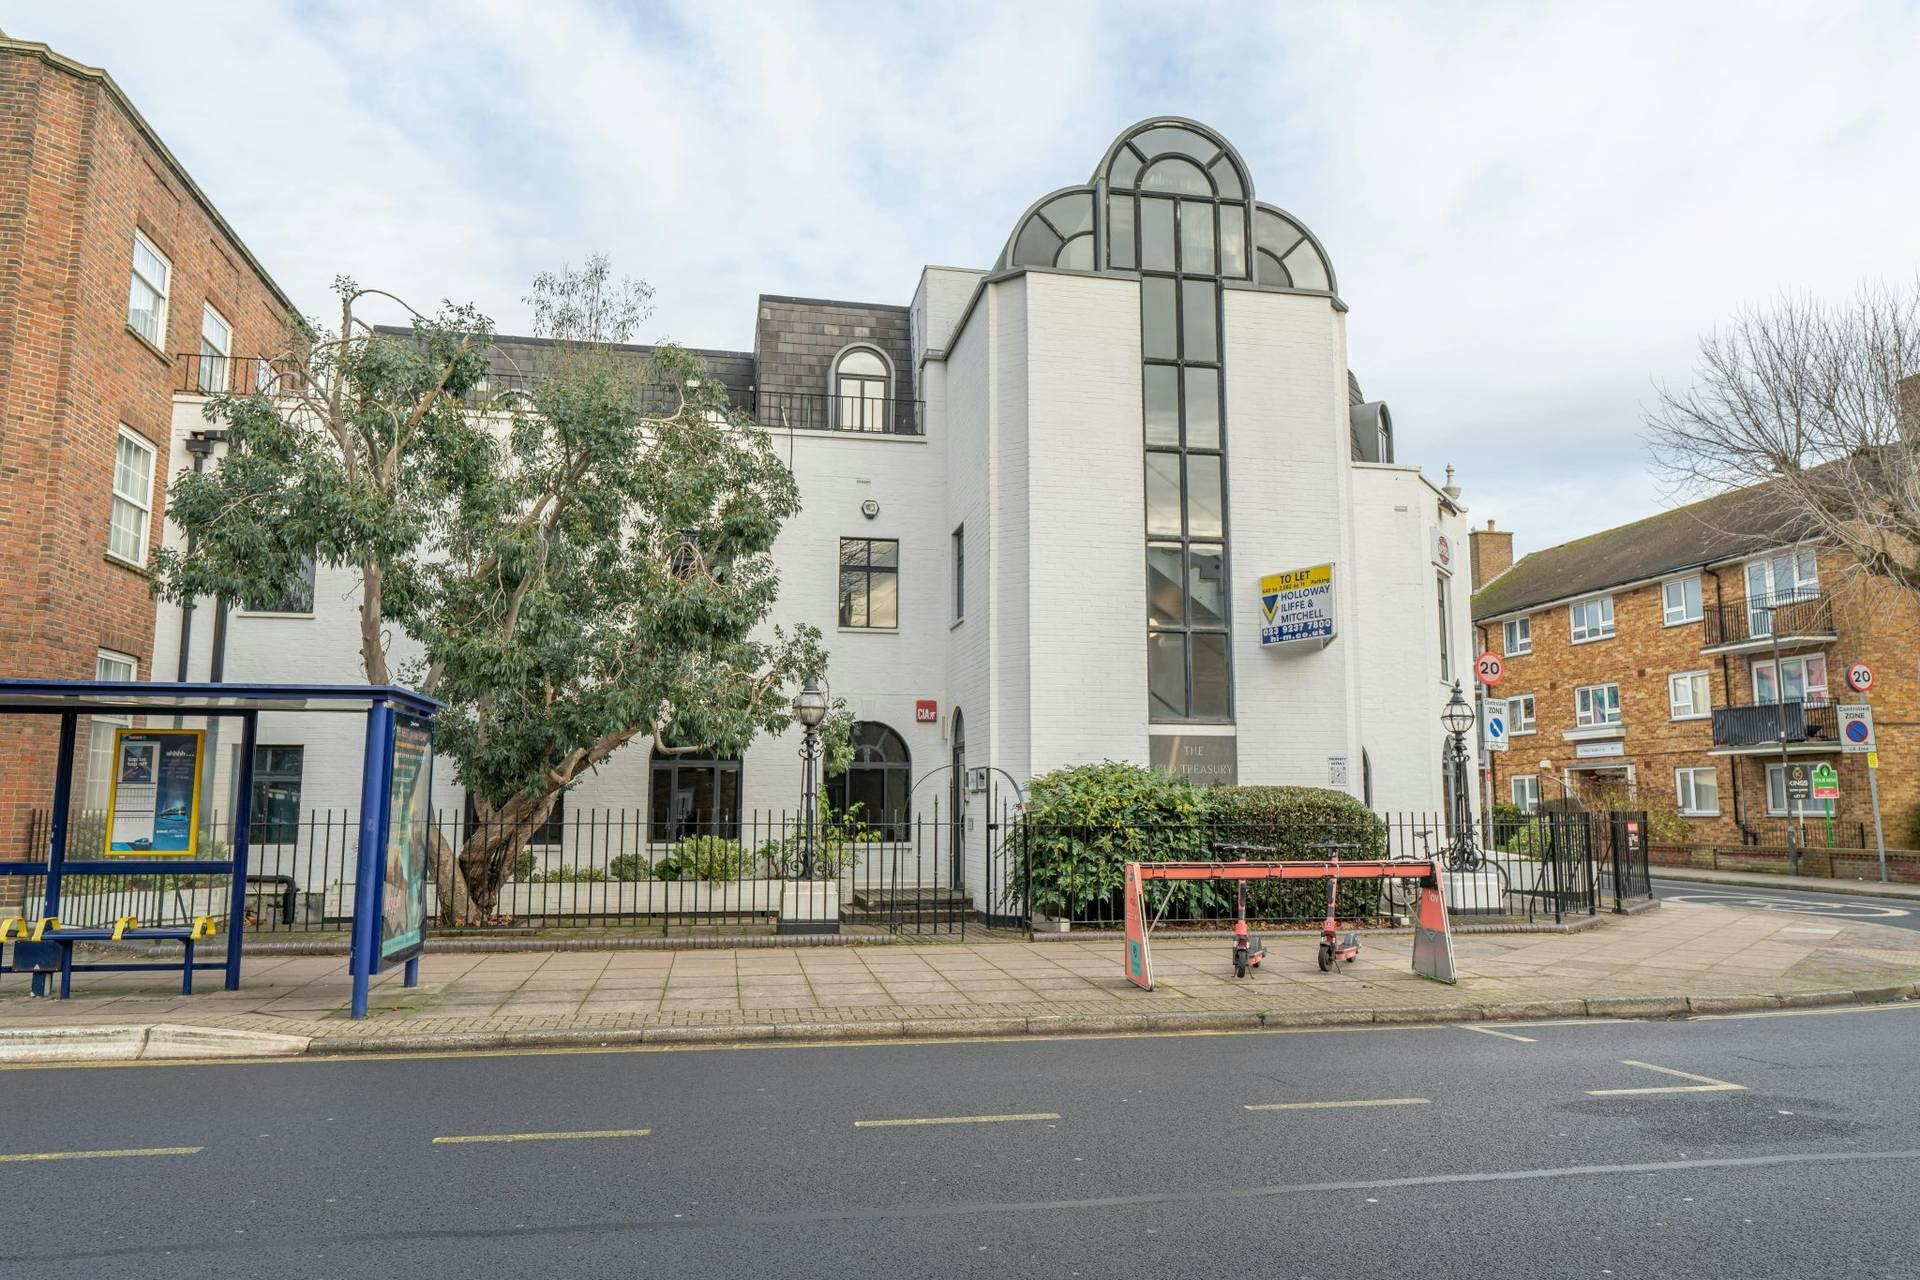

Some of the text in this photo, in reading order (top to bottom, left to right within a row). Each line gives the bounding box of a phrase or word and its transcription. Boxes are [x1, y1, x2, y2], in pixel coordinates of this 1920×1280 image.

[1280, 570, 1310, 584] TO LET
[1281, 584, 1331, 601] HOLLOWAY
[1281, 599, 1313, 612] ILIFFE &
[1281, 608, 1324, 623] MITCHELL
[1263, 620, 1331, 636] 023 9237 7800
[1270, 628, 1326, 642] hi-m.co.uk
[1480, 662, 1500, 675] 20
[1853, 671, 1870, 682] 20
[1484, 699, 1506, 707] Controlled
[1488, 707, 1503, 715] ZONE
[1184, 745, 1205, 756] THE
[1181, 764, 1233, 775] TREASURY
